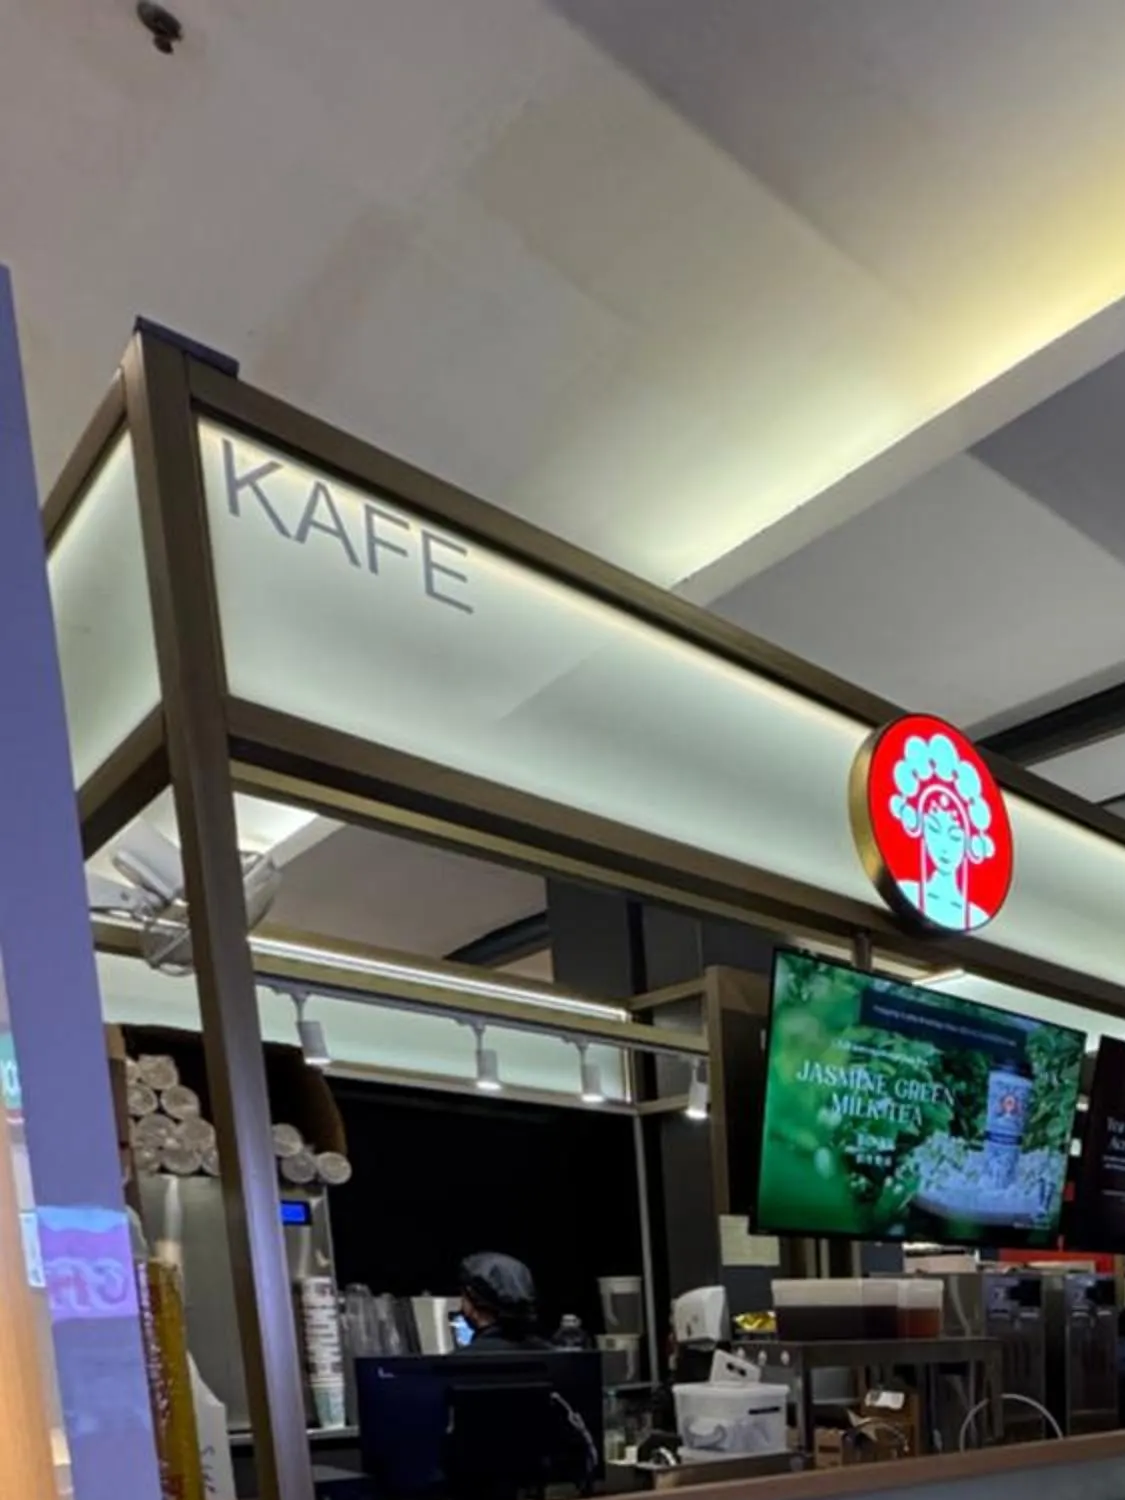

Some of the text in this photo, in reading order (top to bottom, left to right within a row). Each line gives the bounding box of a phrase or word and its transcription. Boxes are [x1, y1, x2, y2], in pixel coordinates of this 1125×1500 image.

[222, 437, 475, 615] KAFE
[796, 1060, 956, 1106] JASMINE GREEN
[831, 1092, 923, 1126] MILK TEA
